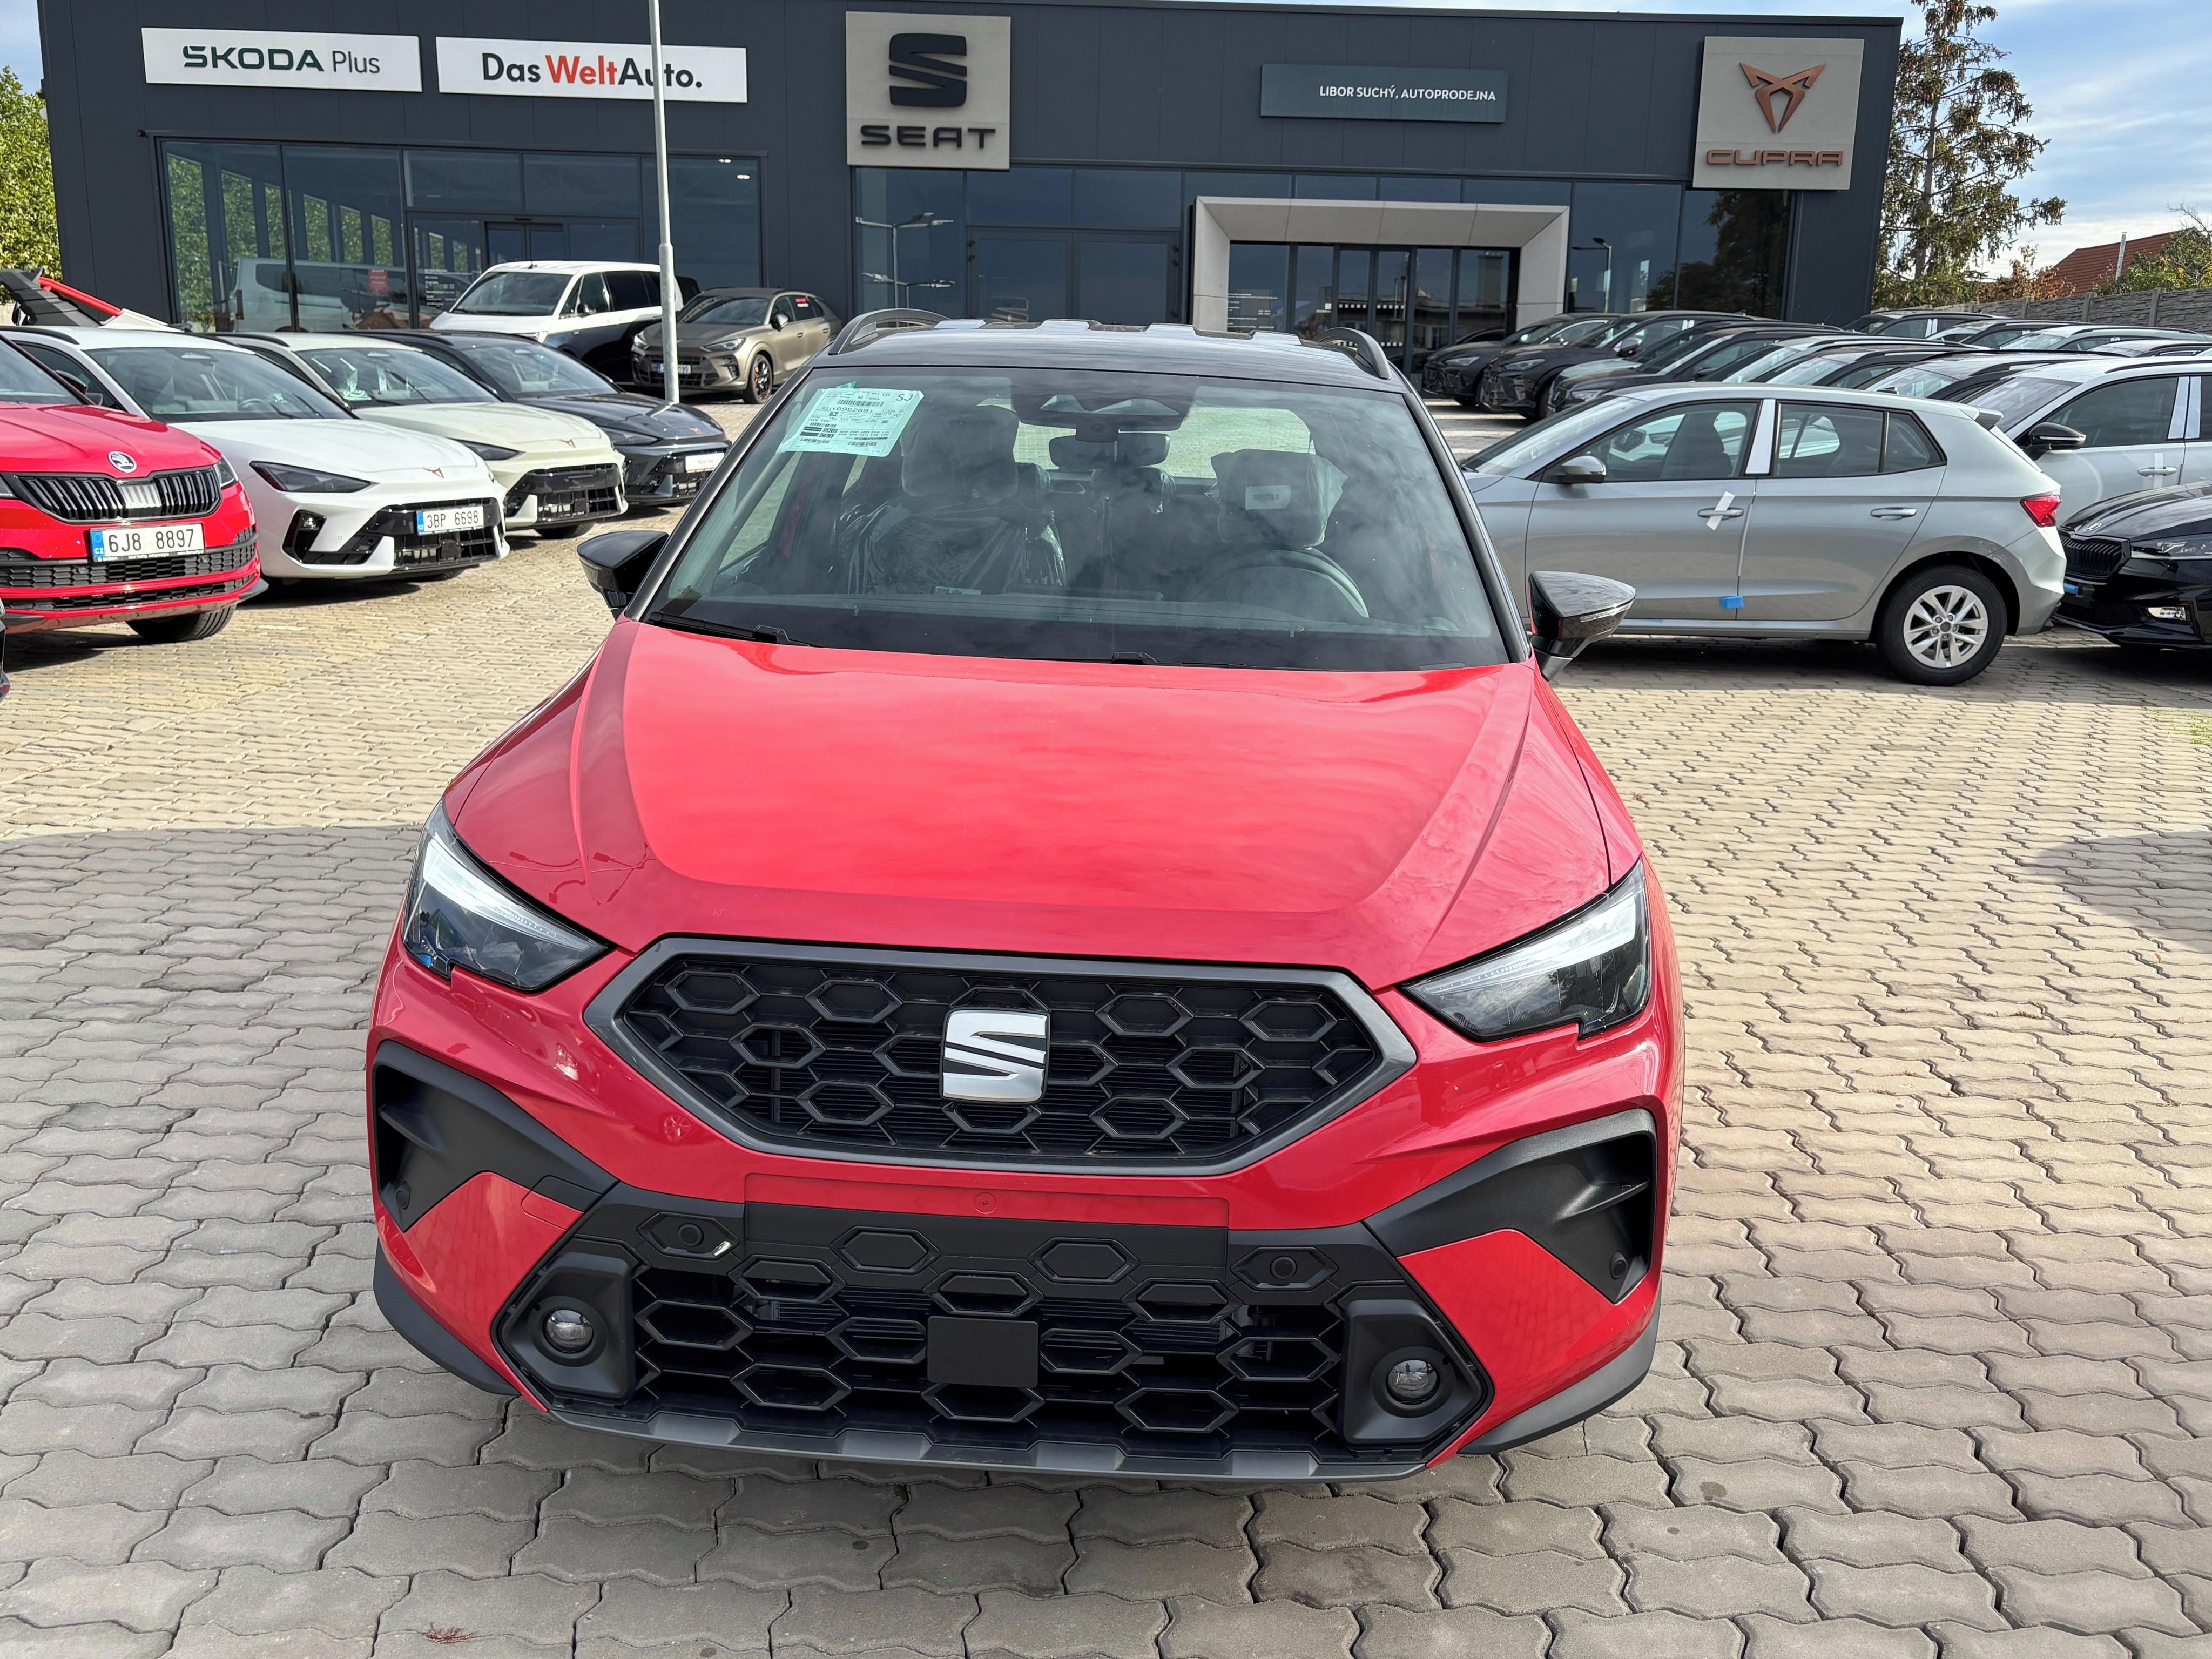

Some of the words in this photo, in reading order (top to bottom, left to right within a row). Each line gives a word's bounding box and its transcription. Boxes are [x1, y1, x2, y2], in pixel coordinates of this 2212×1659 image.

[332, 50, 381, 74] Plus
[482, 52, 541, 83] Das
[1319, 86, 1354, 97] LIBOR
[1356, 85, 1399, 100] SUCHÝ,
[1401, 88, 1496, 101] AUTOPRODEJNA
[860, 125, 996, 149] SEAT
[1707, 149, 1844, 166] CUPRA
[427, 514, 446, 528] 3BP
[455, 510, 478, 525] 6698
[108, 532, 142, 553] 6J8
[155, 529, 194, 549] 8897
